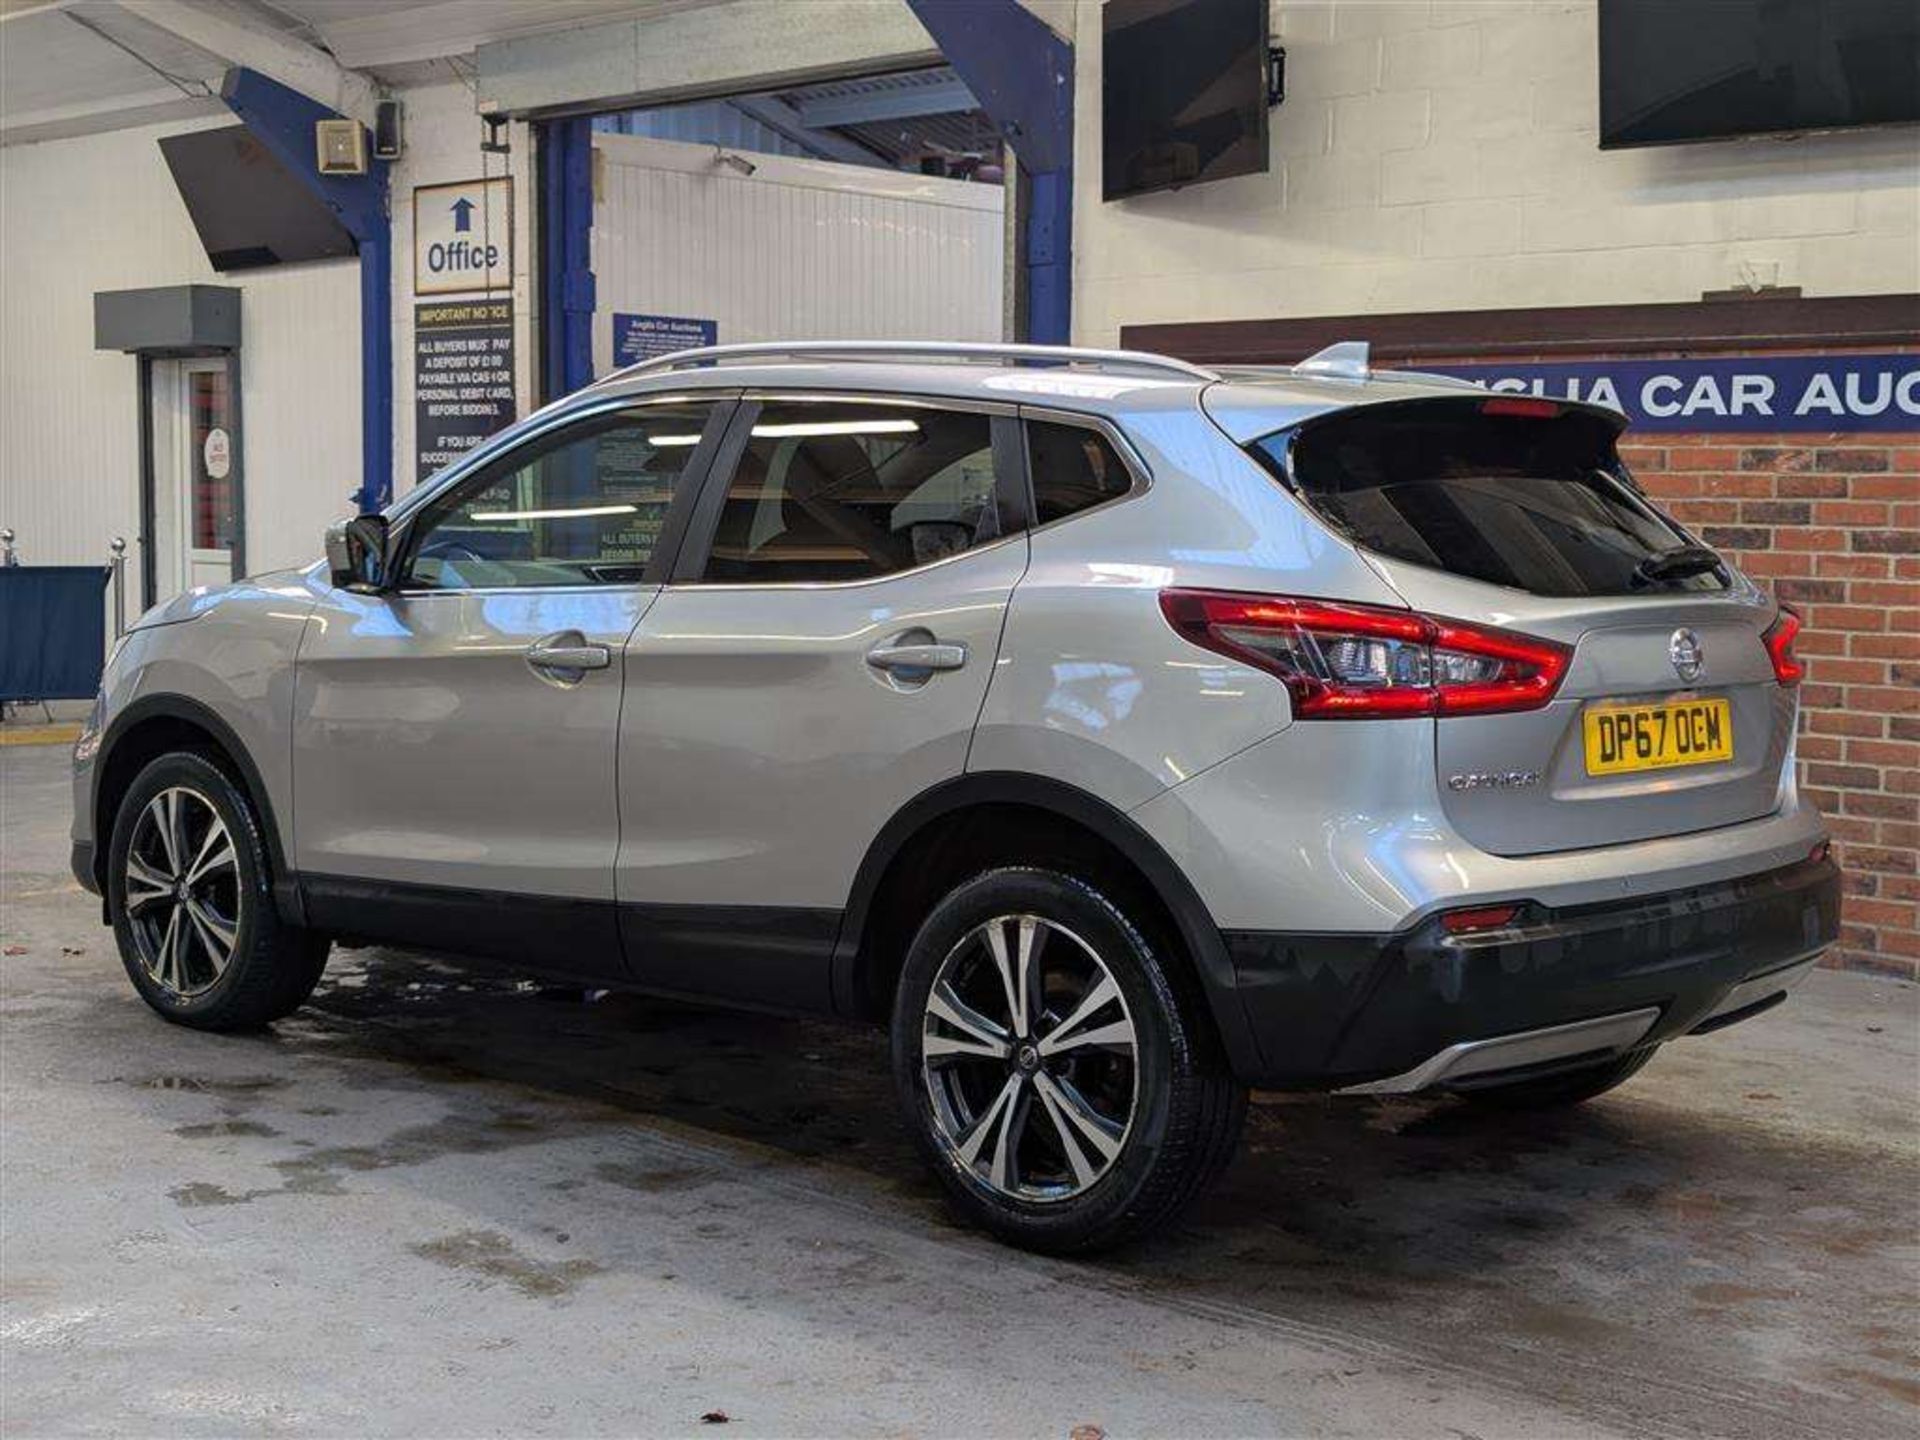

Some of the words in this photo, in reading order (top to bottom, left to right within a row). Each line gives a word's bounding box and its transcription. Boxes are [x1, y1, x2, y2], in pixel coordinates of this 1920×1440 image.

[429, 241, 498, 272] Office
[420, 307, 471, 322] IMPORTANT
[418, 340, 433, 353] ALL
[434, 340, 467, 353] BUYERS
[493, 338, 511, 350] PAY
[425, 357, 432, 368] A
[433, 356, 468, 368] DEPOSIT
[469, 355, 480, 367] OF
[418, 373, 456, 385] PAYABLE
[457, 373, 471, 384] VIA
[497, 370, 510, 383] OR
[417, 389, 458, 401] PERSONAL
[460, 387, 485, 400] DEBIT
[1641, 375, 1775, 417] CAR
[428, 404, 460, 416] BEFORE
[438, 436, 446, 447] IF
[447, 436, 464, 447] YOU
[1600, 710, 1668, 763] DP67
